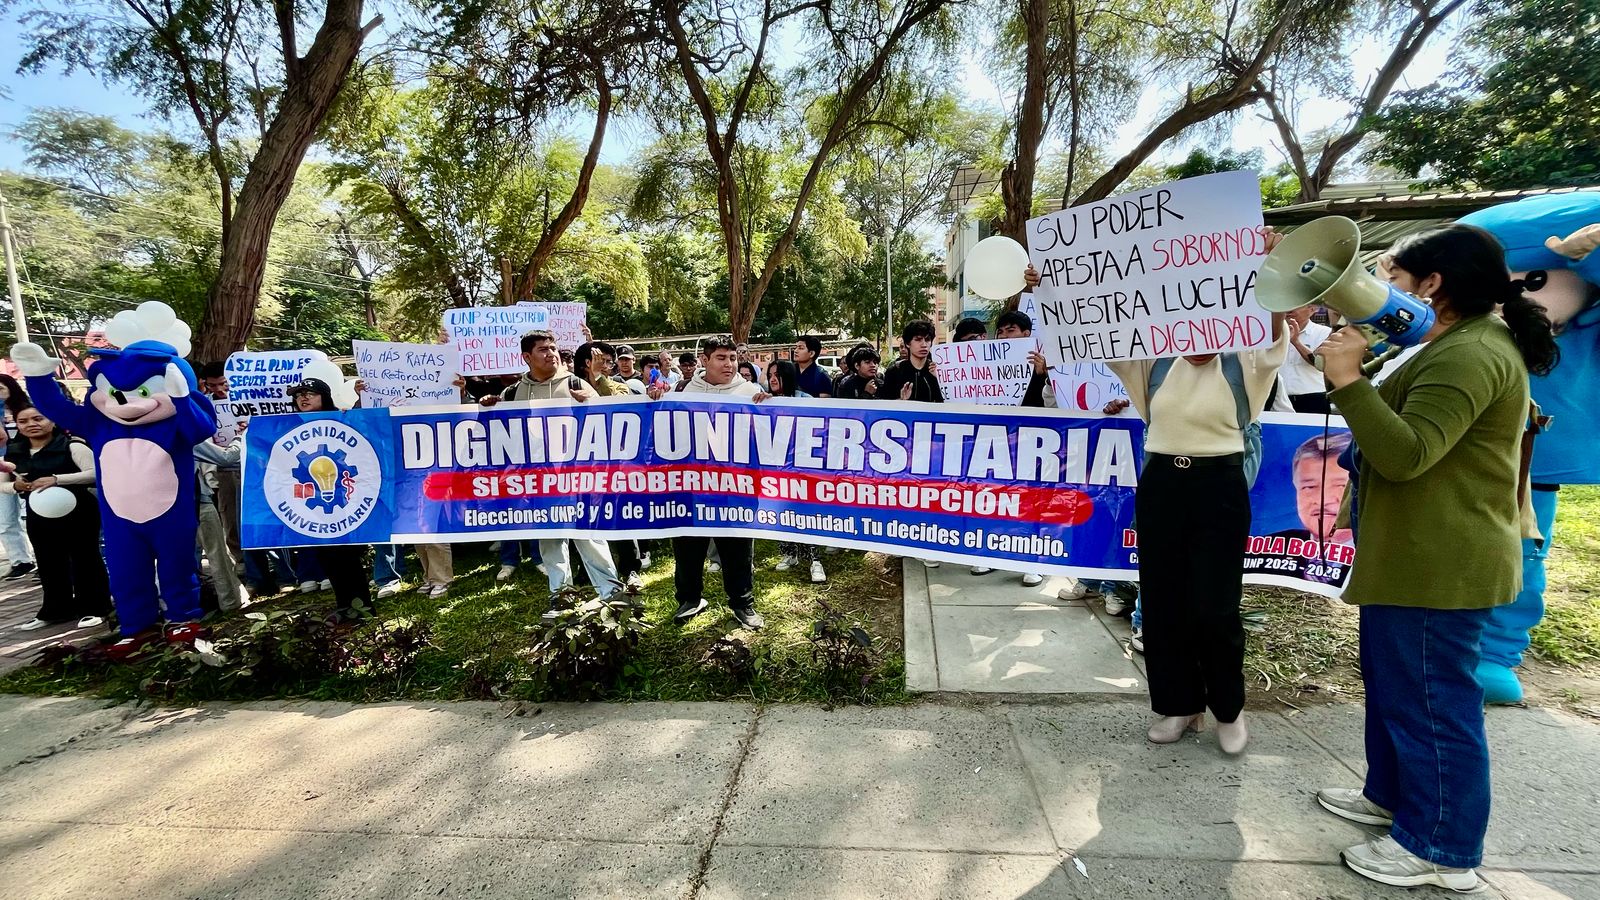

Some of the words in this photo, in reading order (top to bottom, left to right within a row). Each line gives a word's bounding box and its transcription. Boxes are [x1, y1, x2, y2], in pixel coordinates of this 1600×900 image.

[1035, 213, 1077, 251] SU
[1091, 189, 1184, 239] PODER
[1038, 249, 1123, 287] APESTA
[1124, 244, 1146, 277] A
[1152, 224, 1267, 271] SOBORNOS
[1041, 289, 1151, 326] NUESTRA
[1162, 270, 1257, 313] LUCHA
[450, 311, 481, 325] UNP
[453, 325, 474, 337] POR
[478, 325, 518, 337] MAFIAS
[495, 337, 519, 349] NOS
[1058, 329, 1125, 363] HUELE
[1129, 327, 1149, 358] A
[1150, 315, 1266, 356] DIGNIDAD
[254, 359, 267, 372] EL
[405, 351, 445, 369] RATAS
[934, 346, 950, 366] SI
[956, 344, 977, 364] LA
[983, 341, 1011, 361] UNP
[936, 367, 968, 383] FUERA
[970, 366, 993, 381] UNA
[228, 387, 283, 402] ENTONCES
[230, 402, 260, 417] QUE
[281, 426, 358, 453] DIGNIDAD
[401, 412, 642, 470] DIGNIDAD
[653, 410, 1138, 487] UNIVERSITARIA
[472, 476, 500, 497] SI
[505, 474, 538, 495] SE
[542, 472, 609, 494] PUEDE
[611, 471, 755, 495] GOBERNAR
[761, 477, 808, 500] SIN
[815, 480, 1020, 517] CORRUPCIÓN
[277, 496, 374, 534] UNIVERSITARIA
[463, 507, 548, 527] Elecciones
[576, 501, 585, 519] 8
[589, 505, 599, 524] y
[604, 501, 614, 520] 9
[622, 501, 644, 520] de
[649, 500, 692, 522] julio.
[696, 503, 716, 521] Tu
[719, 506, 754, 523] voto
[757, 510, 777, 525] es
[780, 508, 858, 536] dignidad,
[862, 517, 883, 537] Tu
[886, 520, 960, 547] decides
[964, 528, 983, 548] el
[986, 531, 1069, 558] cambio.
[1264, 557, 1298, 572] 2025
